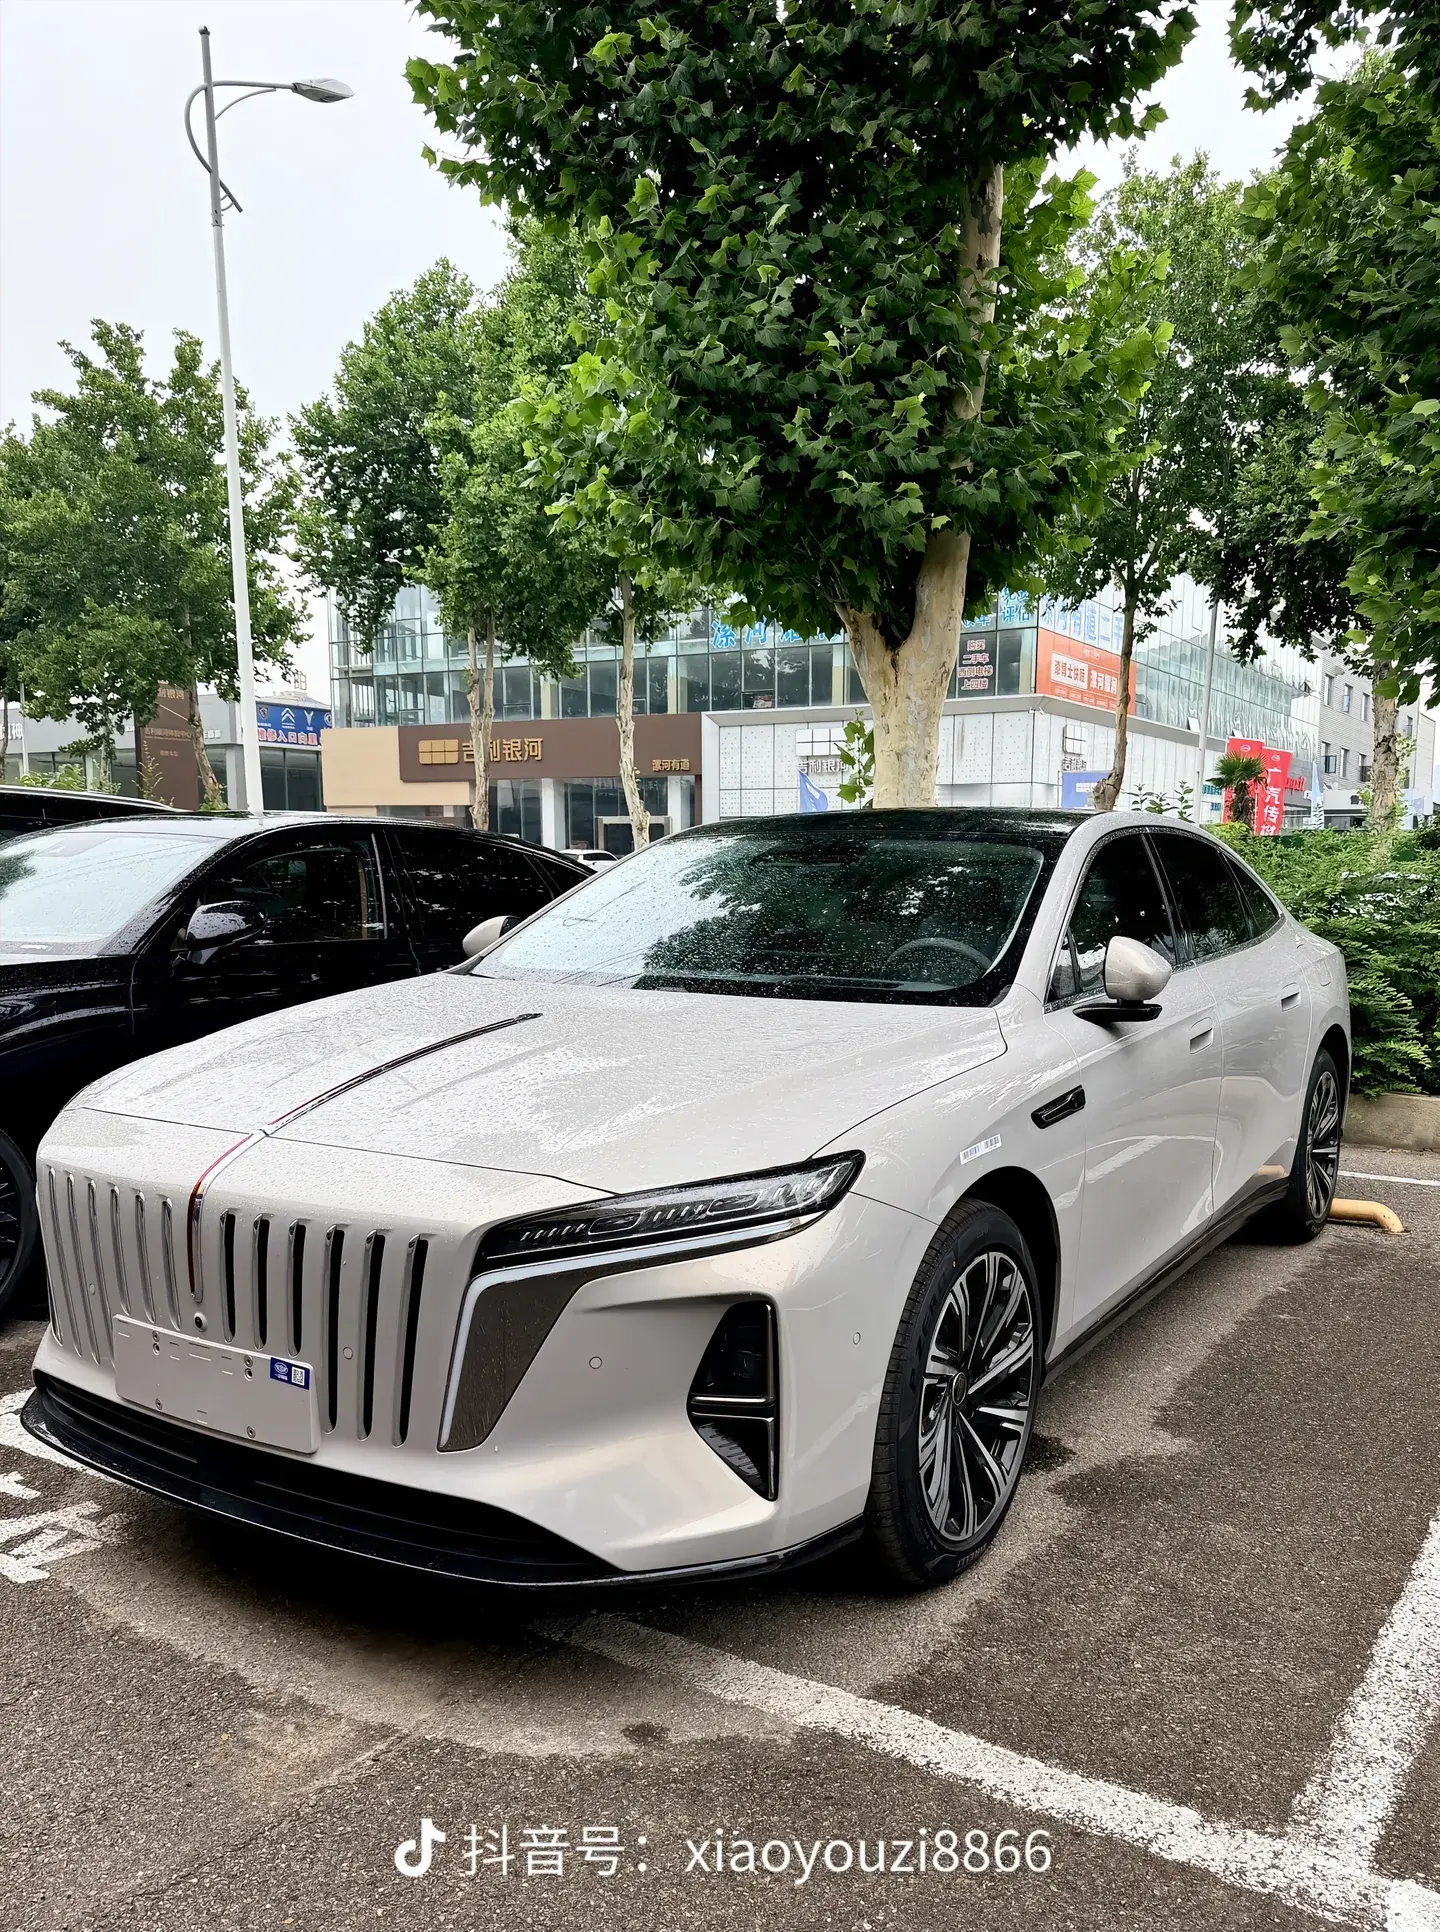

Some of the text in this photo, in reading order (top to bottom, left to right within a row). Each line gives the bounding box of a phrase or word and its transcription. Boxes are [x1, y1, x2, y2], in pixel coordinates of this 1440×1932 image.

[962, 653, 989, 664] 二手车
[958, 665, 993, 677] 西侧电梯
